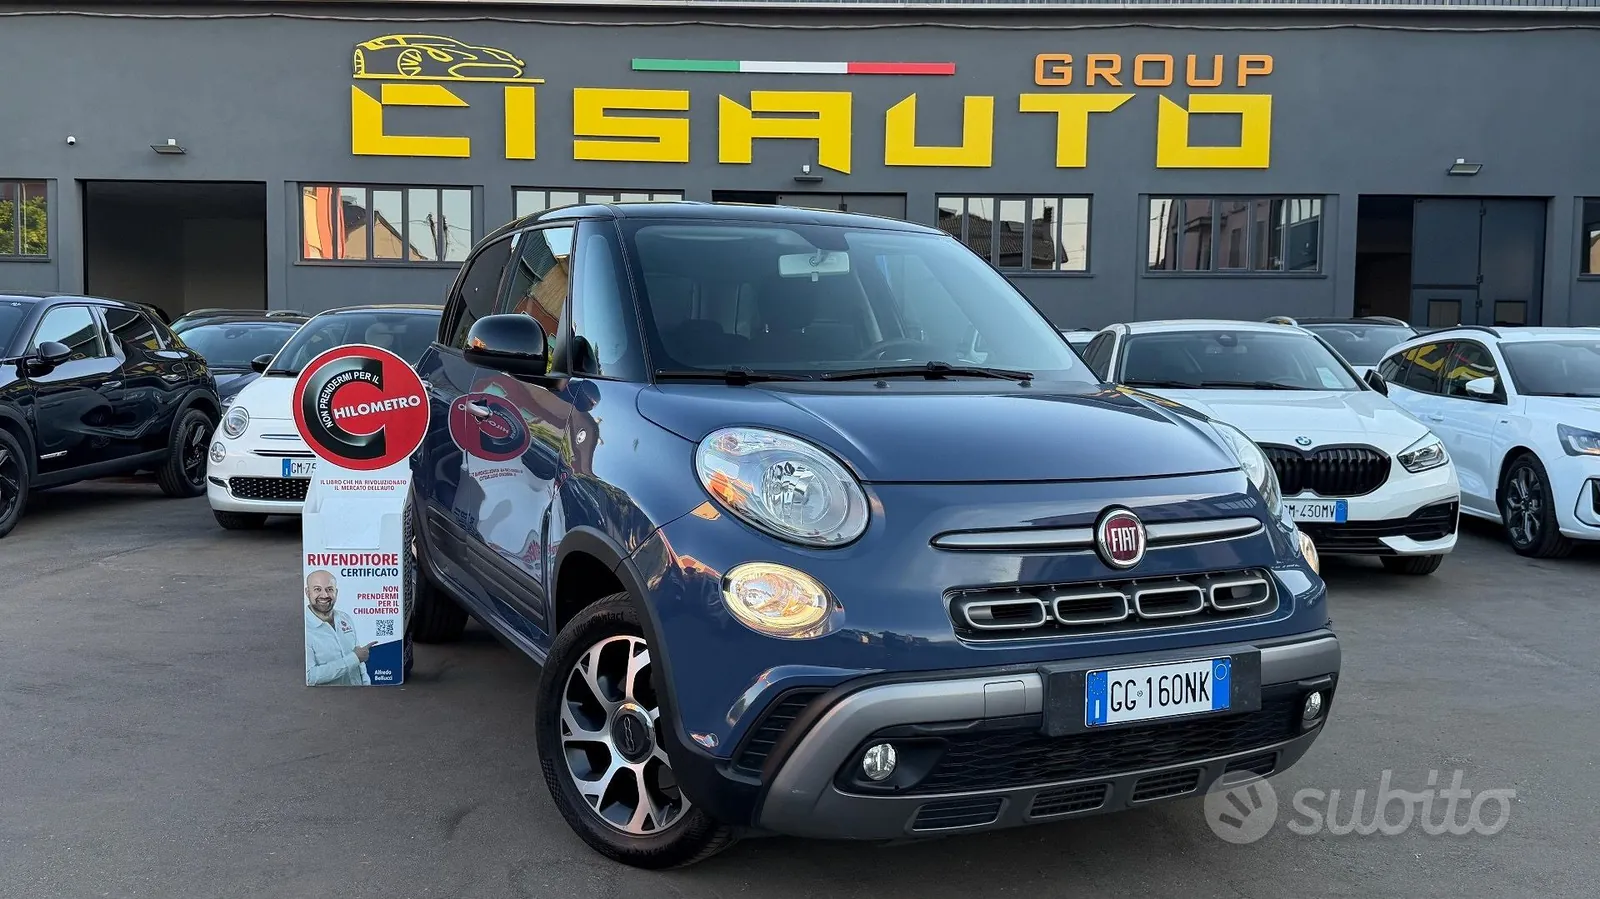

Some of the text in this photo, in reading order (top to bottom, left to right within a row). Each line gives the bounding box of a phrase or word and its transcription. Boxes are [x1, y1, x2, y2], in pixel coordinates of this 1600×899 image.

[1034, 53, 1274, 87] GROUP
[351, 83, 1272, 174] CISAUTO
[320, 371, 380, 429] NON PRENDERMI PER IL
[1110, 526, 1136, 552] FIAT
[307, 553, 399, 566] RIVENDITORE
[340, 568, 399, 577] CERTIFICATO
[353, 607, 399, 615] CHILOMETRO
